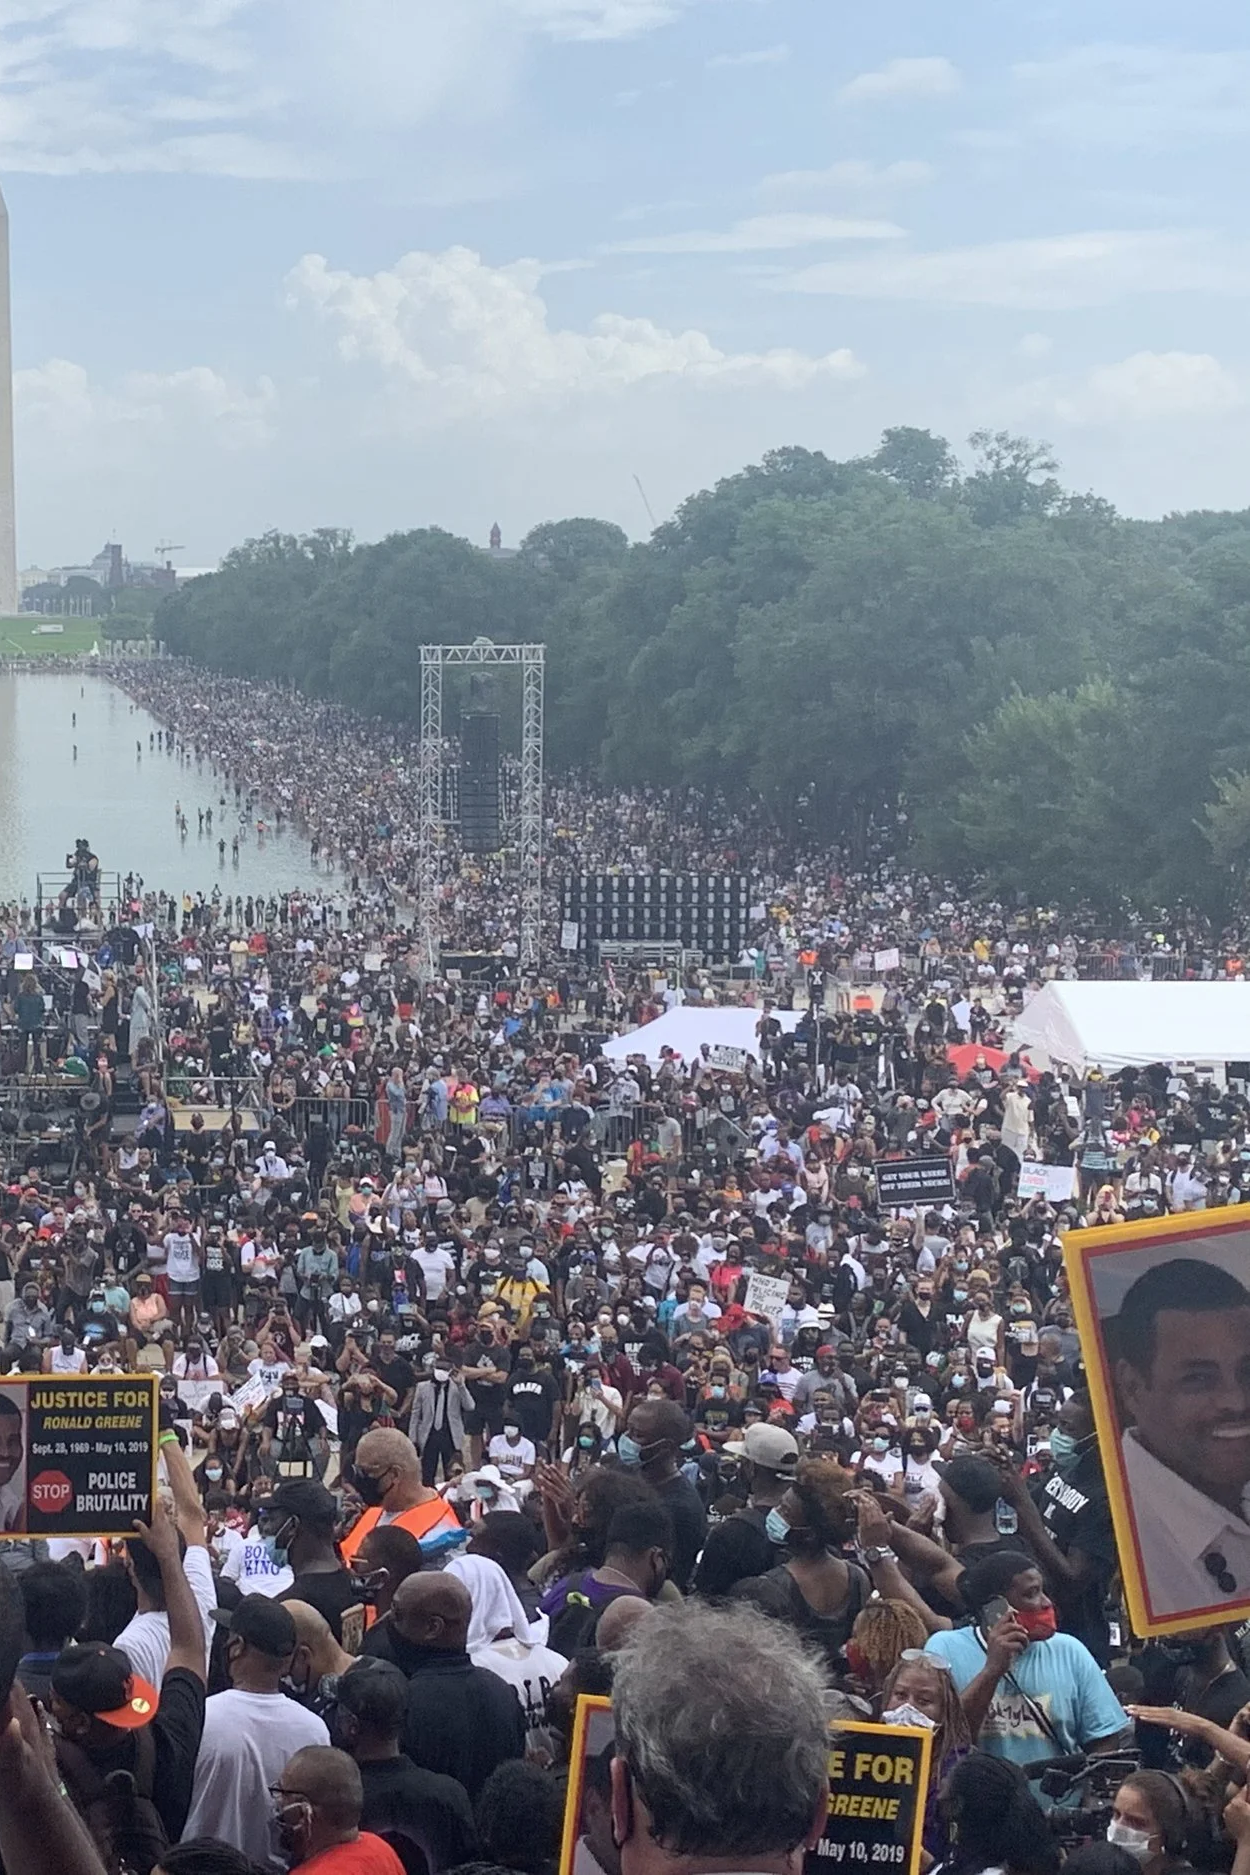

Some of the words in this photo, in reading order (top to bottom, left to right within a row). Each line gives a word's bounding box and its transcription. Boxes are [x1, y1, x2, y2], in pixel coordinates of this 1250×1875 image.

[882, 1173, 897, 1181] GET
[1023, 1166, 1049, 1176] BLACK
[880, 1182, 896, 1191] OFF
[30, 1391, 108, 1409] JUSTICE
[113, 1390, 150, 1408] FOR
[43, 1416, 92, 1430] RONALD
[95, 1415, 143, 1429] GREENE
[32, 1443, 53, 1456] Sept.
[96, 1442, 113, 1455] May
[114, 1442, 127, 1454] 10,
[128, 1441, 149, 1453] 2019
[88, 1472, 137, 1490] POLICE
[33, 1484, 70, 1500] STOP
[76, 1494, 149, 1512] BRUTALITY
[854, 1753, 914, 1785] FOR
[817, 1838, 846, 1861] May
[850, 1841, 868, 1863] 10,
[872, 1843, 905, 1863] 2019
